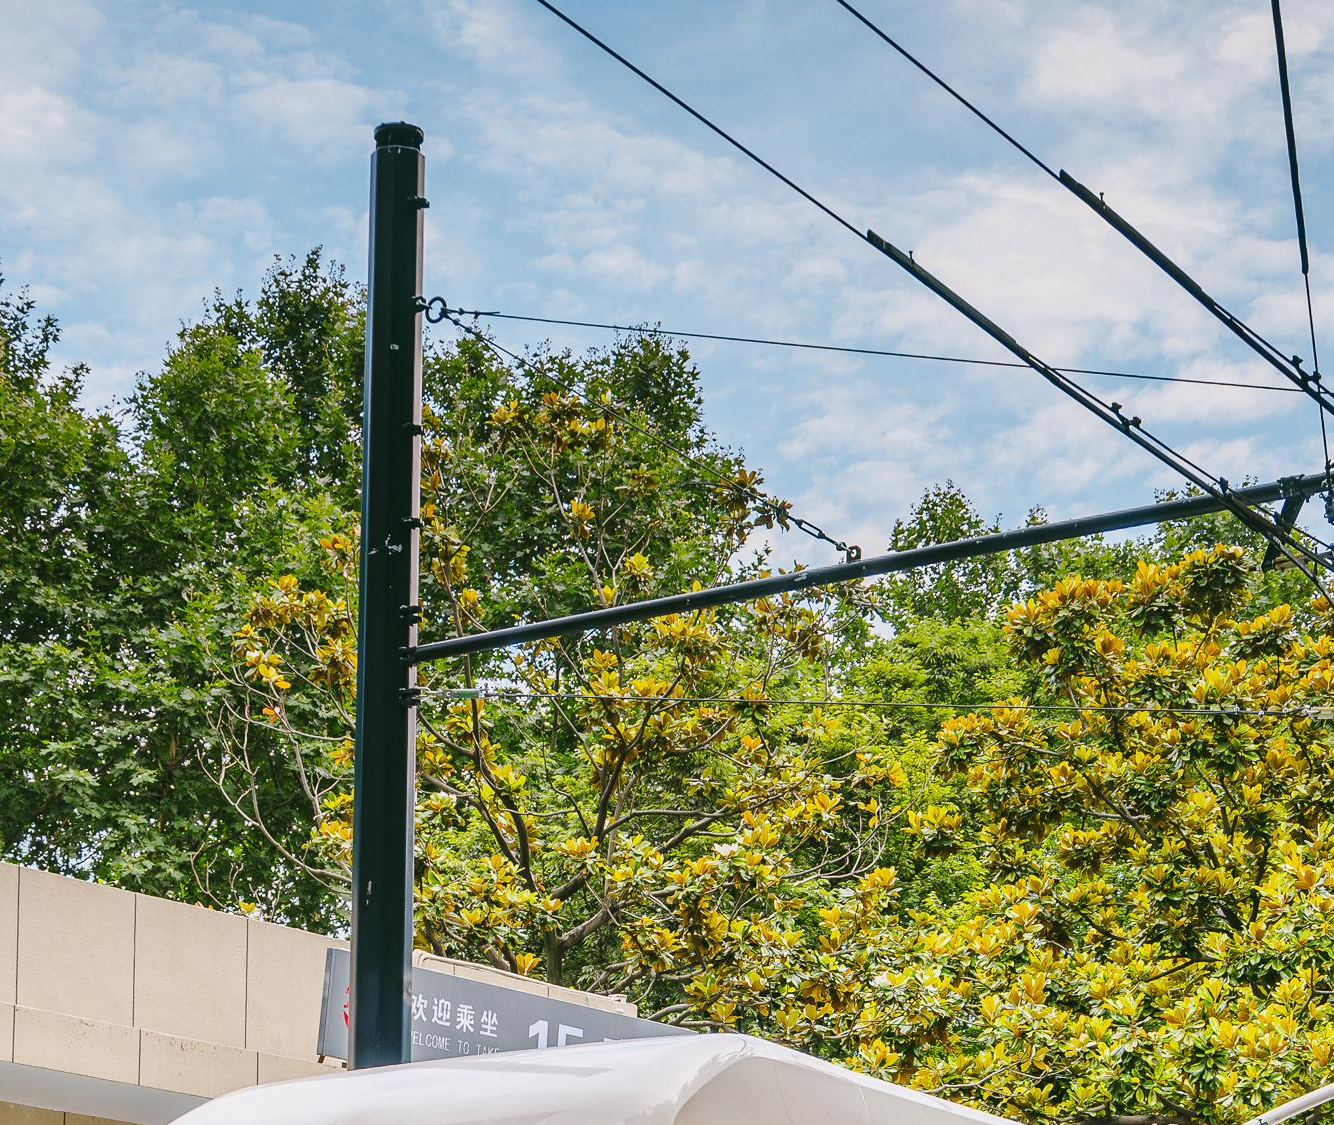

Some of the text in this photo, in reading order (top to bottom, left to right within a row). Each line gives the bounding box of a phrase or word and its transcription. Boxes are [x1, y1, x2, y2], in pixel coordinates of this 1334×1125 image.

[411, 994, 499, 1038] 欢迎乘坐
[457, 1039, 470, 1055] TO
